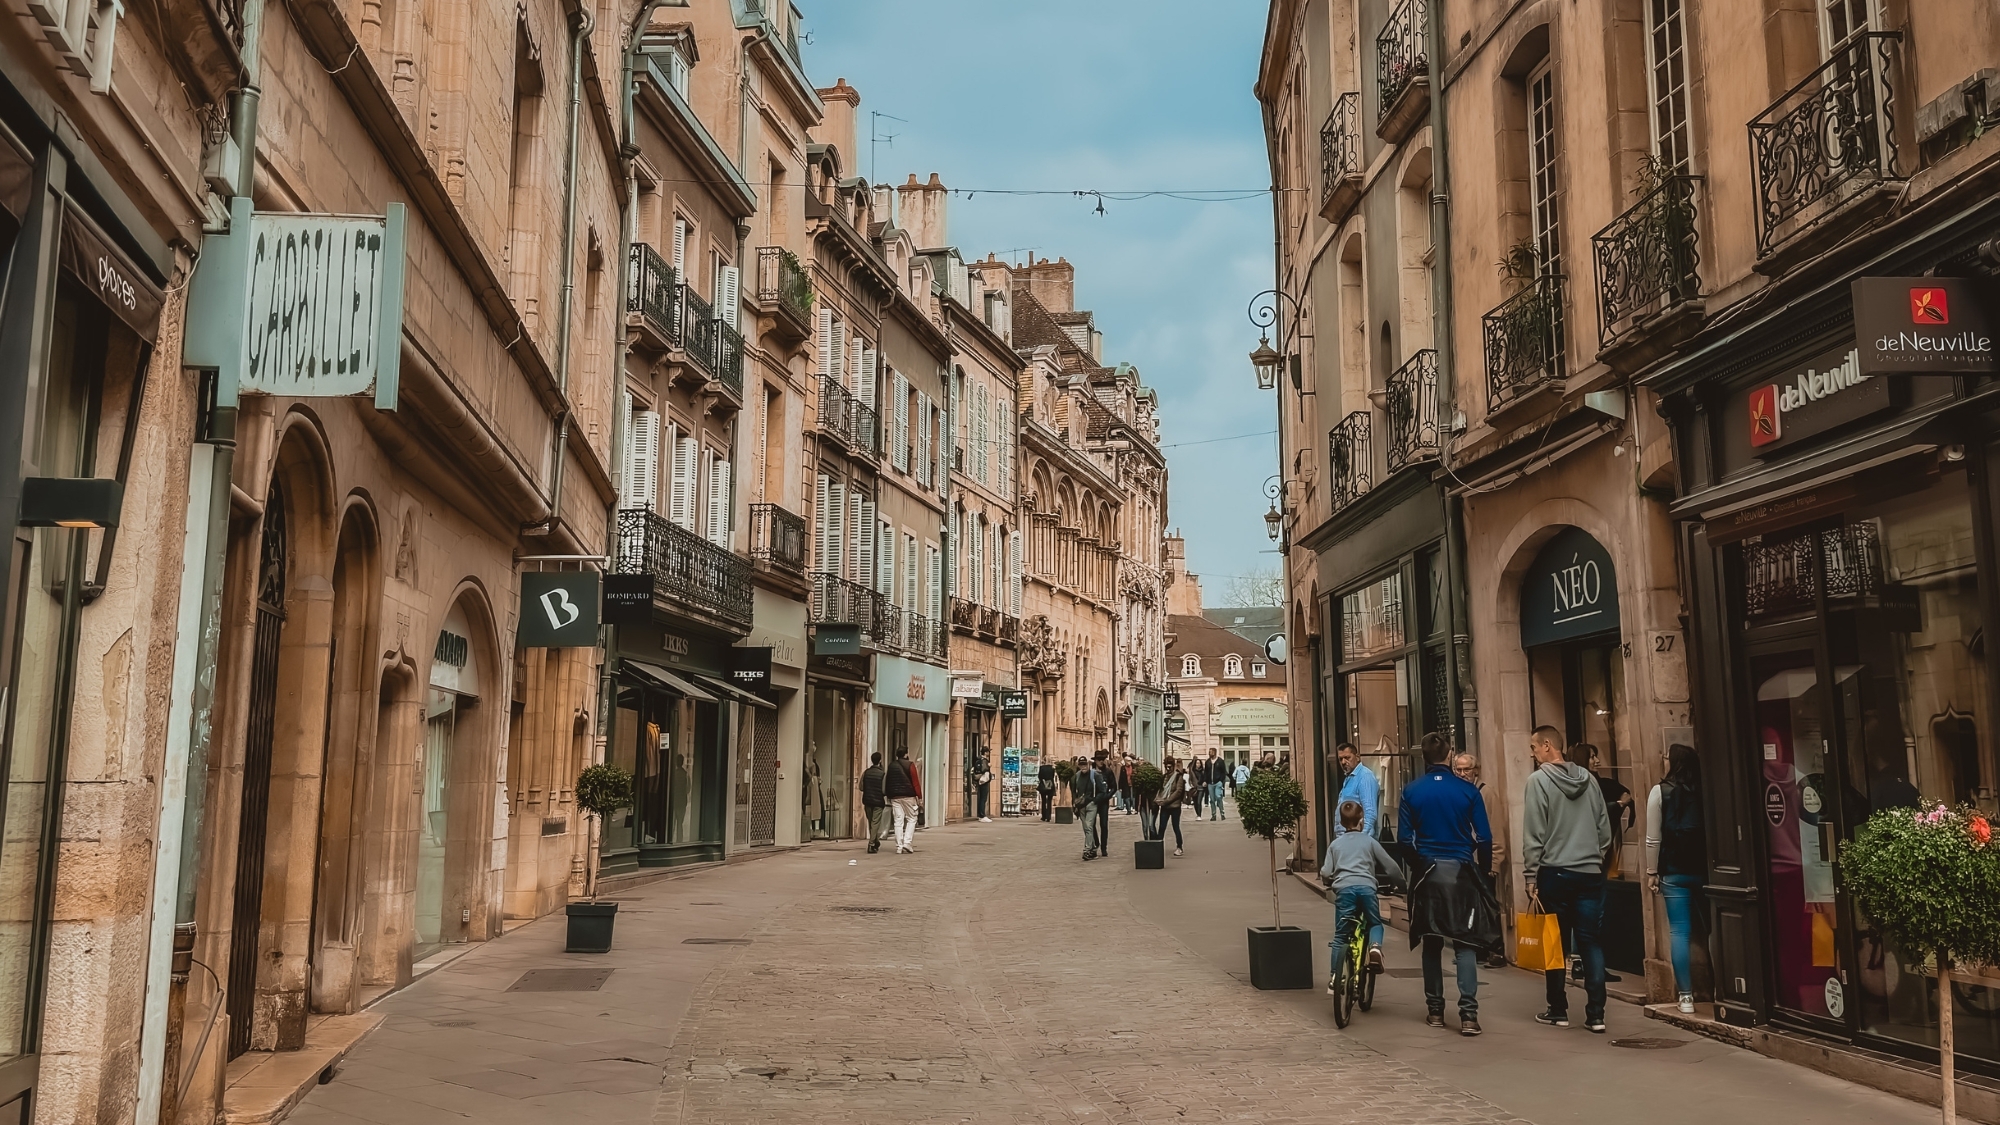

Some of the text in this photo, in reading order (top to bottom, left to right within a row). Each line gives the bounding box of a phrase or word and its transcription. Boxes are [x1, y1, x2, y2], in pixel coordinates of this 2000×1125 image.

[99, 255, 136, 310] glaces
[1875, 331, 1992, 352] deNeuville
[1780, 348, 1874, 412] deNeuvill
[1551, 552, 1600, 613] NÉO
[540, 588, 579, 630] B
[663, 633, 689, 655] IKKS
[1655, 635, 1675, 652] 27
[733, 670, 764, 678] IKKS
[954, 684, 980, 694] albane
